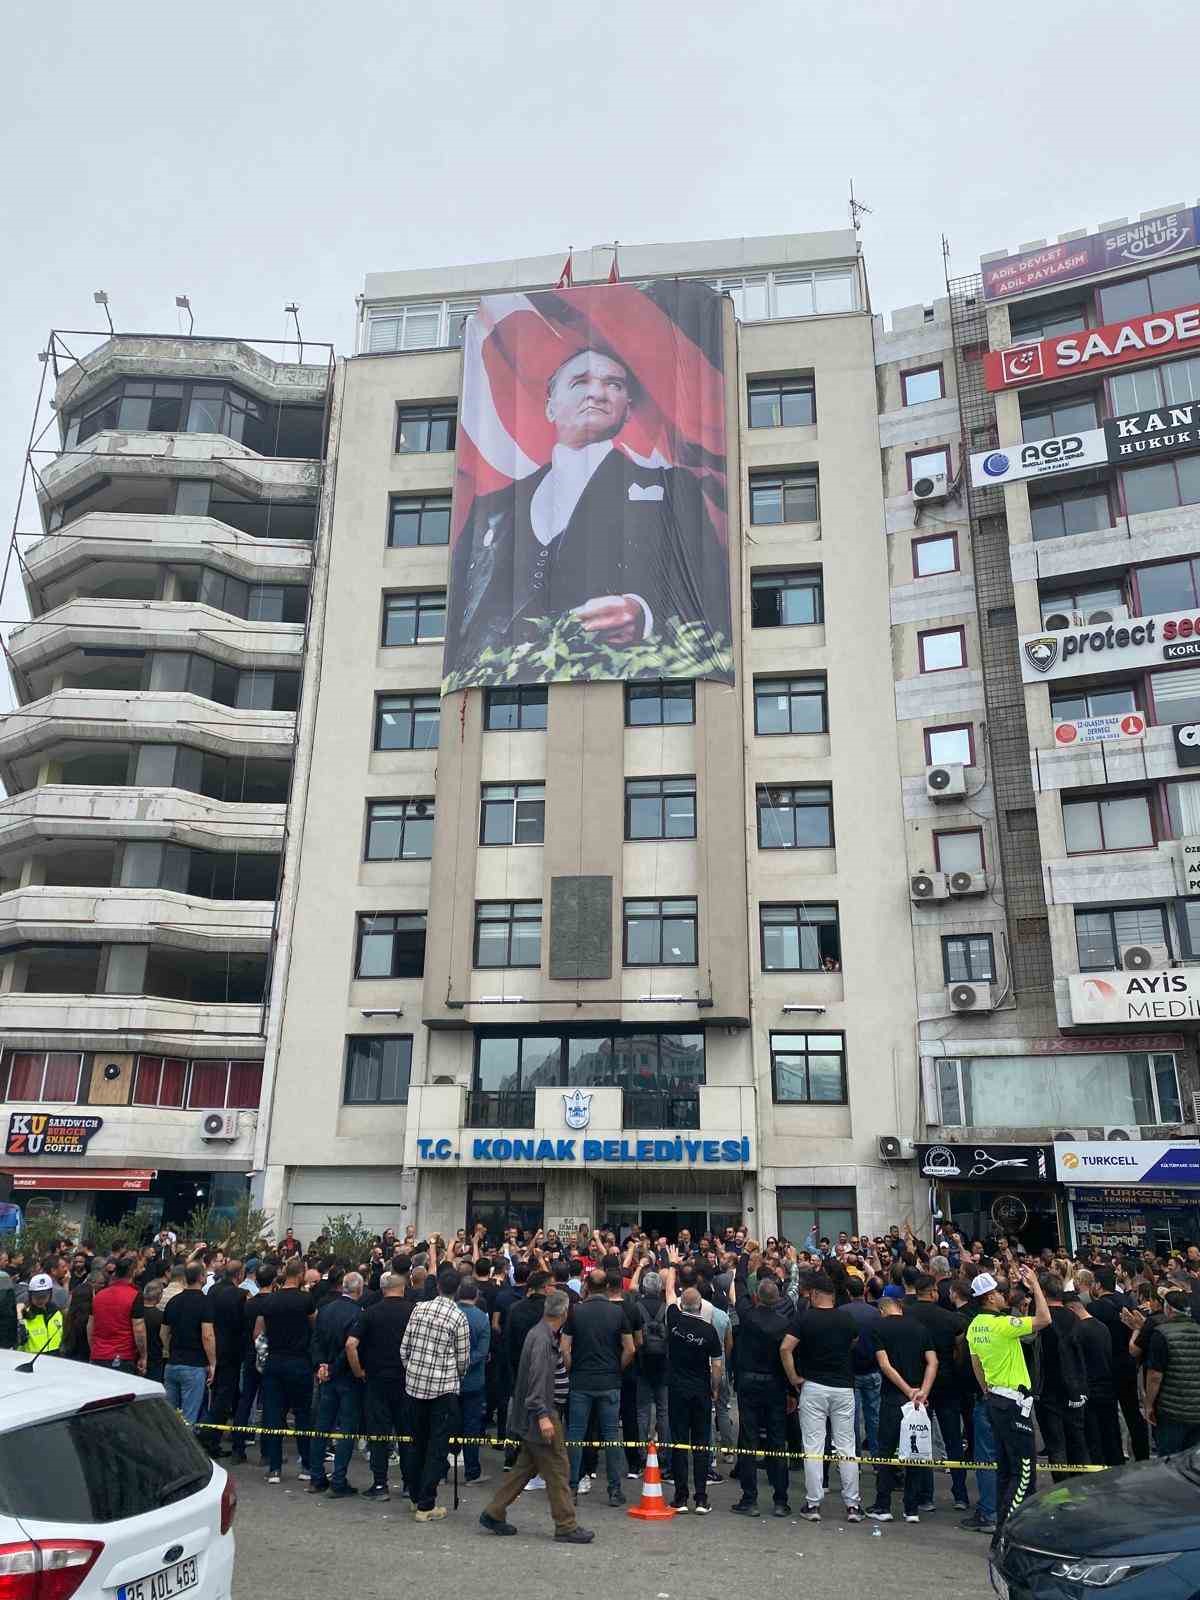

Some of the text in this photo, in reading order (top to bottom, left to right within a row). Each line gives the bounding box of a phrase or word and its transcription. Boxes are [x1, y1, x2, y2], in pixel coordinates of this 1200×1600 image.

[1105, 214, 1177, 250] SENİNLE
[1131, 227, 1178, 253] OLUR
[1020, 248, 1062, 271] DEVLET
[1056, 309, 1200, 366] SAADE
[1116, 405, 1200, 438] KAN
[1021, 437, 1082, 462] AGD
[1119, 432, 1191, 455] HUKUK
[1062, 618, 1155, 662] protect
[1127, 972, 1188, 994] AYİS
[1128, 996, 1200, 1018] MEDİ
[11, 1115, 48, 1133] KU
[48, 1119, 98, 1127] SANDWICH
[8, 1134, 44, 1152] ZU
[44, 1144, 83, 1152] COFFEE
[417, 1135, 750, 1163] T.C. KONAK BELEDİYESİ
[1082, 1156, 1138, 1166] TURKCELL
[151, 1571, 172, 1600] ADL
[177, 1559, 196, 1588] 463
